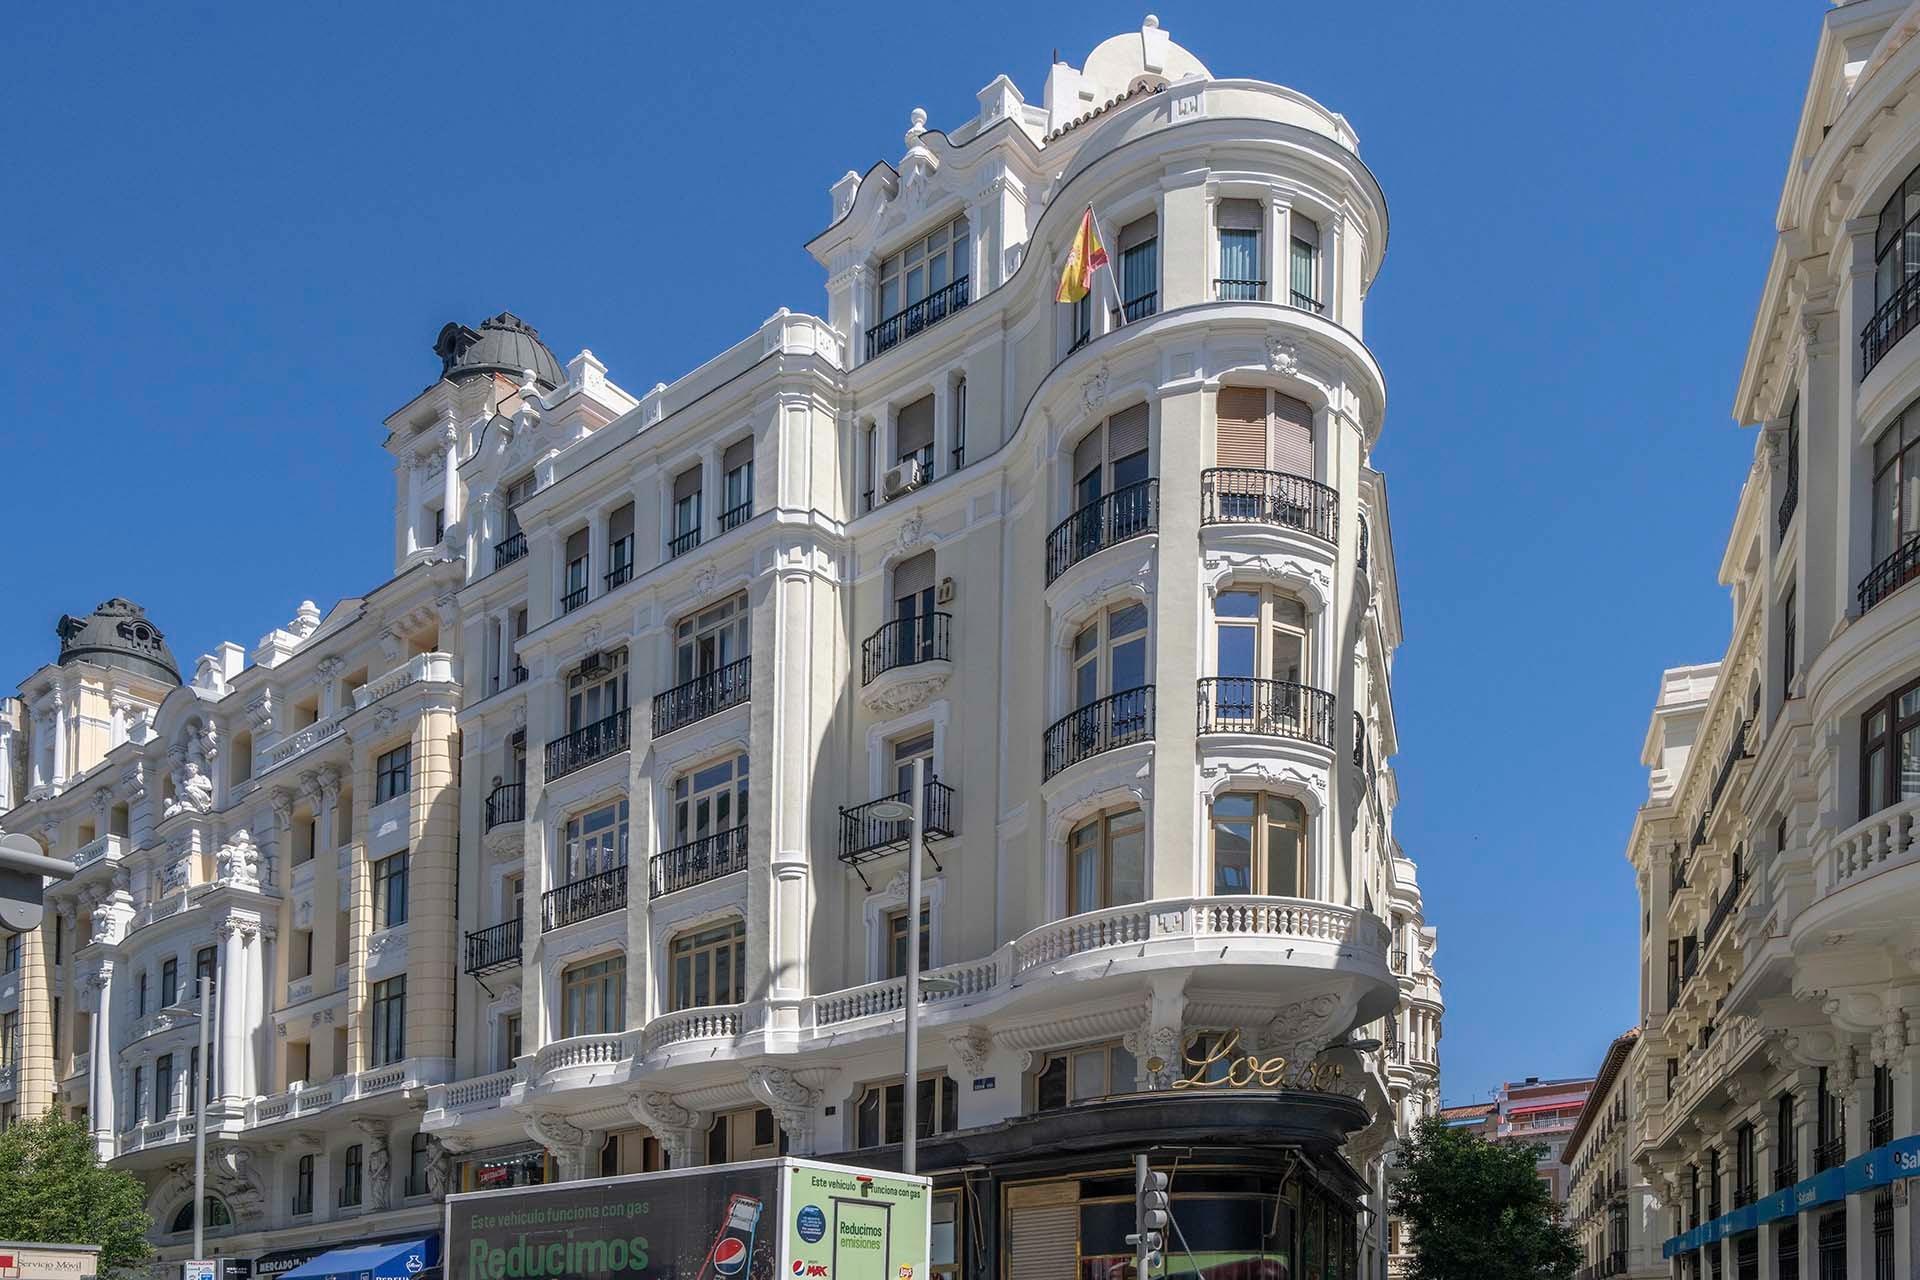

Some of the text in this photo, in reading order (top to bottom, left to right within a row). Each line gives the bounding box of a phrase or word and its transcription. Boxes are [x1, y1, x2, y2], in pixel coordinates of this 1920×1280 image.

[811, 1175, 827, 1187] Este
[898, 1188, 910, 1198] con
[909, 1190, 921, 1200] gas
[471, 1214, 496, 1230] Este
[547, 1205, 600, 1222] funciona
[601, 1202, 625, 1217] con
[627, 1201, 649, 1218] gas
[840, 1221, 882, 1237] Reducimos
[840, 1236, 881, 1250] emisiones
[469, 1229, 649, 1280] Reducimos
[19, 1259, 54, 1270] Servicio
[56, 1261, 81, 1270] Móvil
[260, 1259, 293, 1273] MERCADO
[806, 1265, 828, 1277] MAX
